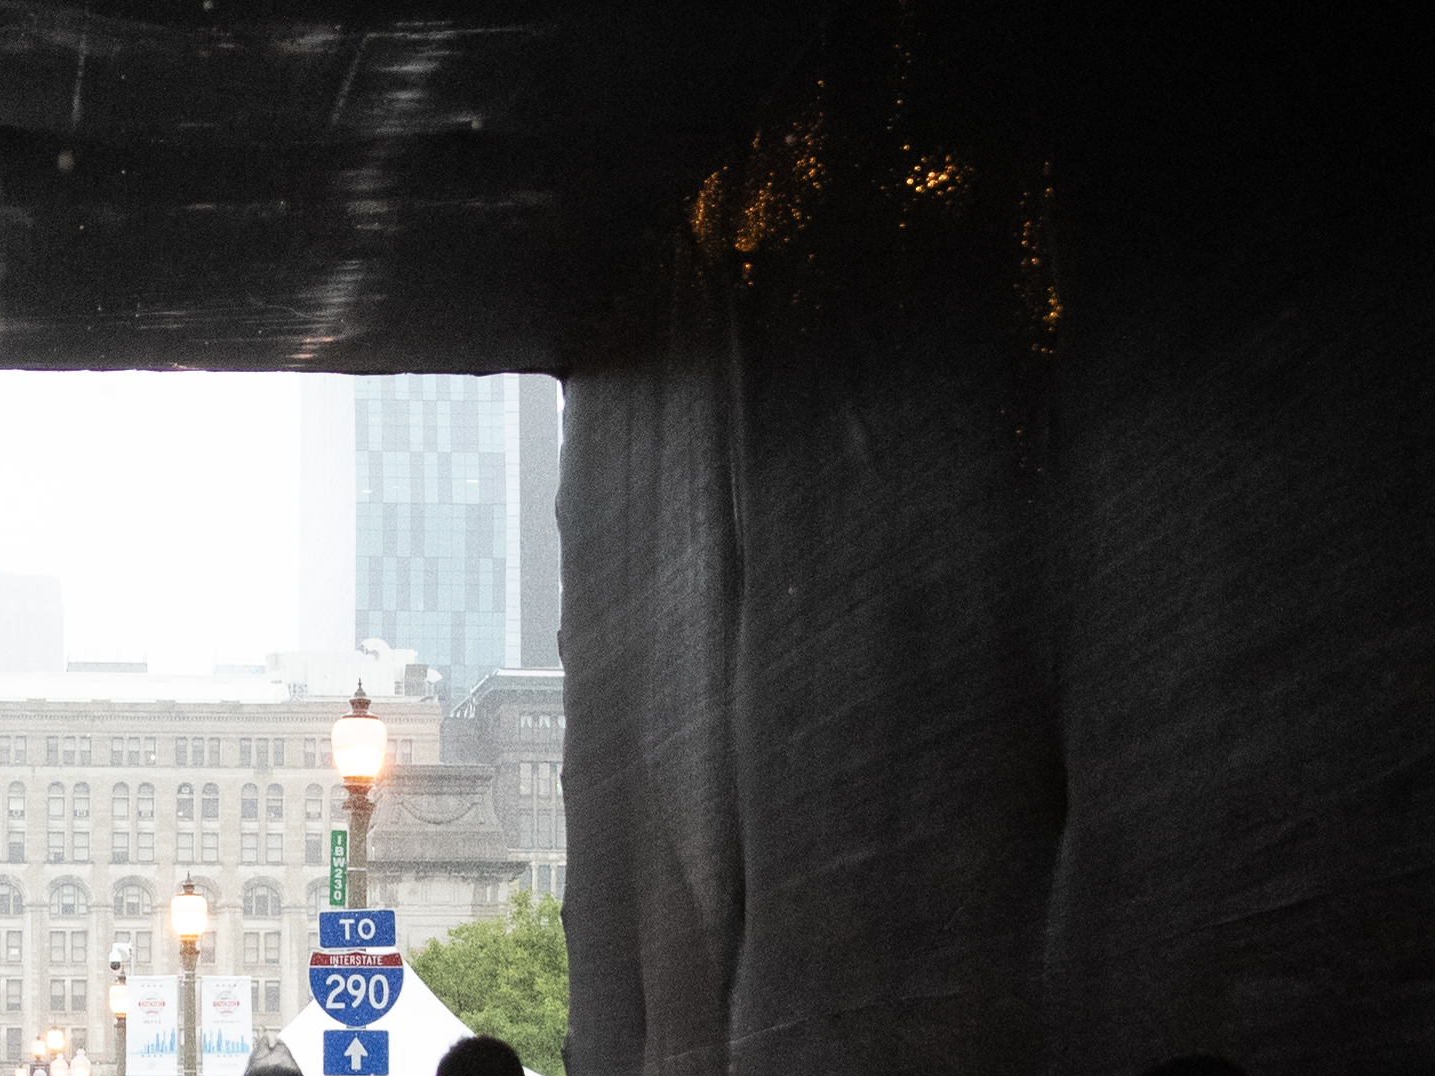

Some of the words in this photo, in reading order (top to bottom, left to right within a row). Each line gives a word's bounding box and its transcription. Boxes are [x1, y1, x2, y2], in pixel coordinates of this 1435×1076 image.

[332, 834, 345, 901] IBW230
[339, 917, 376, 941] TO
[329, 954, 383, 966] INTERSTATE
[325, 973, 390, 1010] 290
